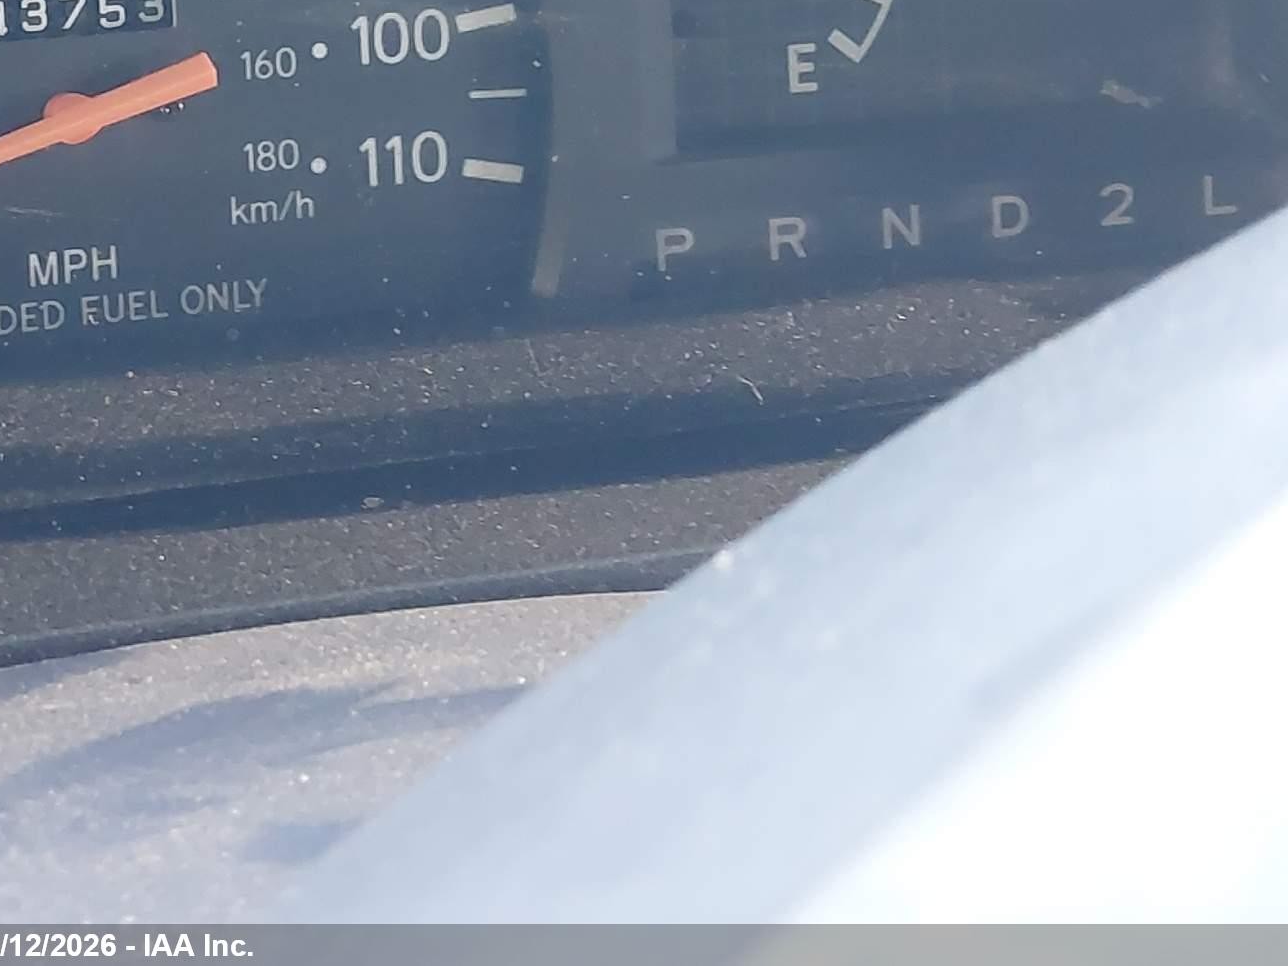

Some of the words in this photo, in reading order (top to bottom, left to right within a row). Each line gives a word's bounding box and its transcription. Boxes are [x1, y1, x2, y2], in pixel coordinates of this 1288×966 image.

[350, 8, 450, 66] 100
[239, 46, 297, 81] 160
[787, 42, 819, 94] E
[242, 138, 301, 174] 180
[358, 130, 448, 187] 110
[229, 190, 315, 225] km/h
[655, 227, 695, 272] P
[768, 216, 807, 261] R
[882, 204, 921, 249] N
[991, 194, 1030, 238] D
[1099, 182, 1135, 226] 2
[1202, 174, 1238, 217] L
[27, 245, 119, 288] MPH
[81, 289, 169, 326] FUEL
[181, 278, 269, 316] ONLY
